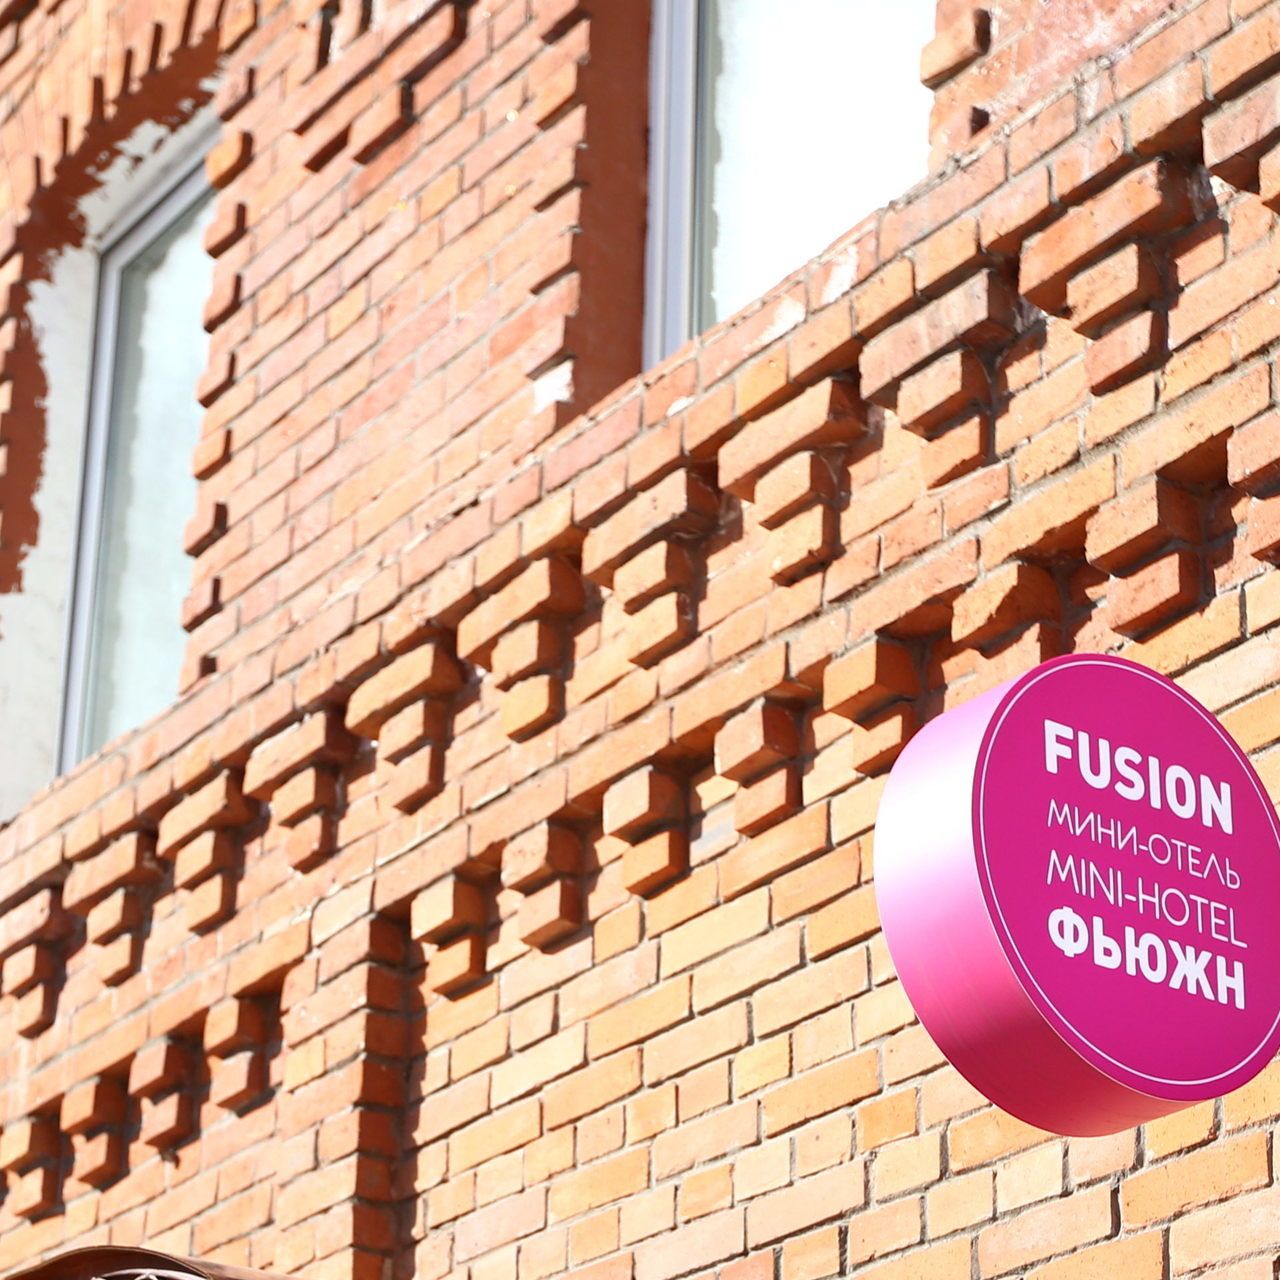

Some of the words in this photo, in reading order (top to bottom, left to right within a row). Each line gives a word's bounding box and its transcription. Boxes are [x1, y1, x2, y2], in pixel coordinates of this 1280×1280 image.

[1043, 718, 1234, 835] FUSION
[1047, 798, 1242, 890] МИНИ-ОТЕЛЬ
[1047, 849, 1248, 948] MINI-HOTEL
[1046, 905, 1245, 1010] ФЬЮЖН
